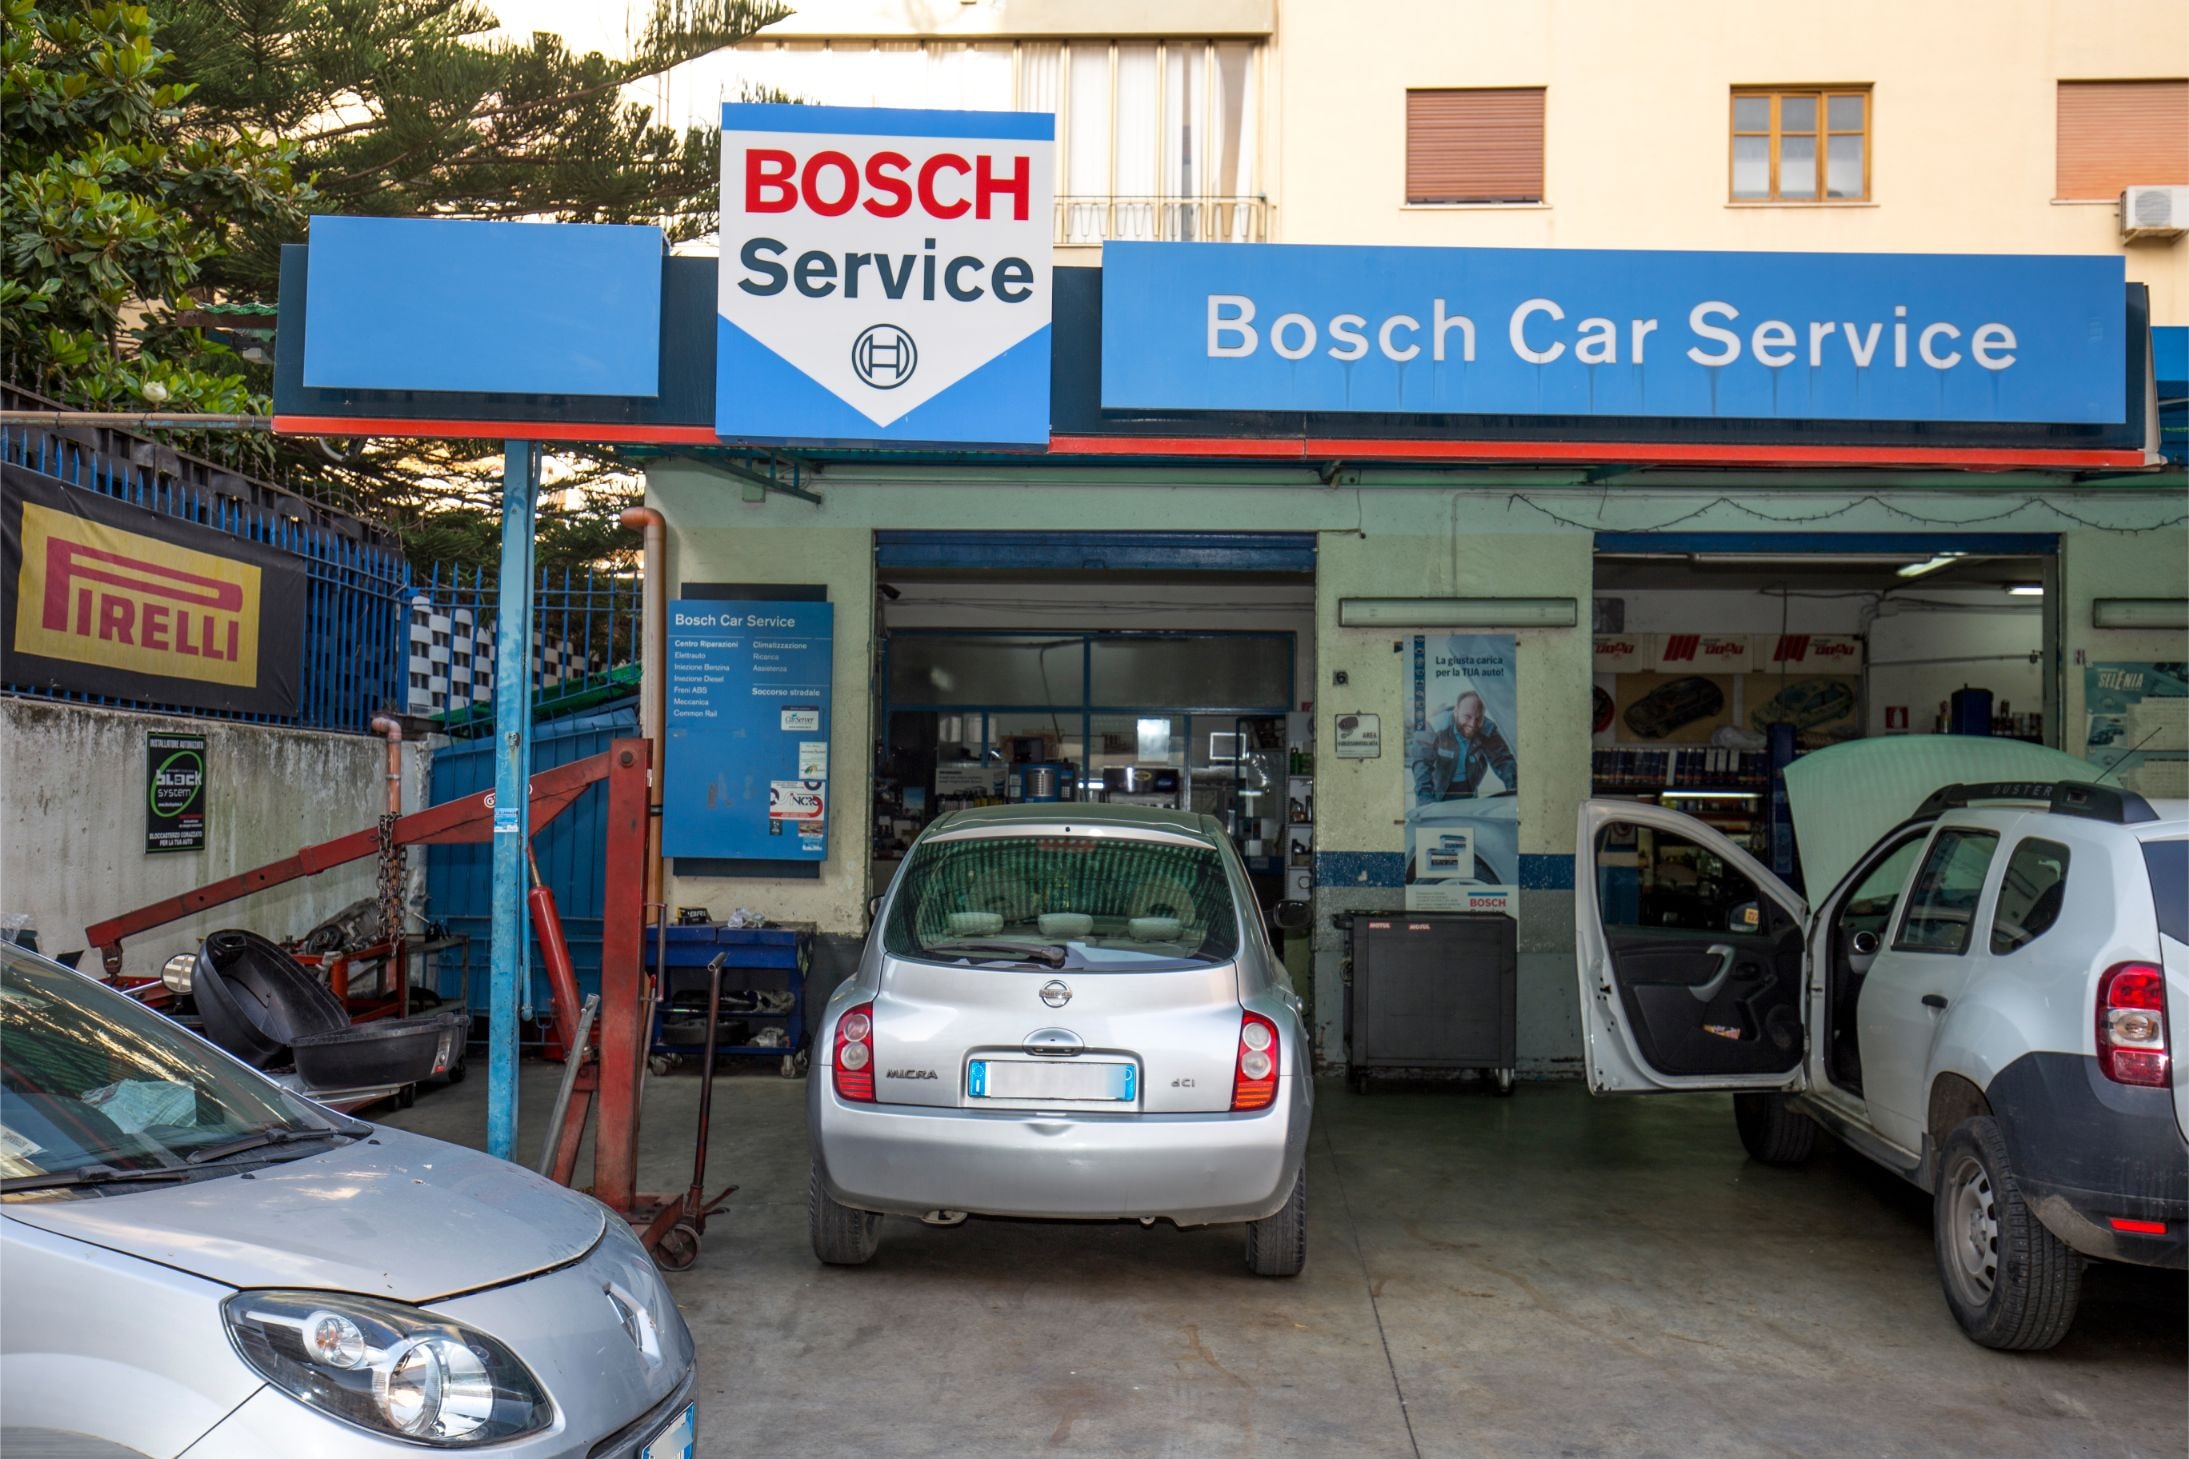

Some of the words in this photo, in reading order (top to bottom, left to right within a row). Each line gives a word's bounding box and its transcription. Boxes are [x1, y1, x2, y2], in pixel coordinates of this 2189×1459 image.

[744, 148, 1031, 222] BOSCH
[737, 237, 1035, 304] Service
[1205, 293, 1477, 363] Bosch
[1507, 297, 1659, 365] Car
[1686, 300, 2018, 371] Service
[42, 536, 244, 662] PIRELLI
[675, 613, 716, 626] Bosch
[720, 614, 743, 627] Car
[747, 615, 796, 628] Service
[674, 640, 699, 648] Centro
[700, 640, 739, 649] Riparazioni
[752, 641, 808, 649] Climatizzazione
[674, 651, 706, 659] Elettrauto
[1435, 656, 1446, 665] La
[1448, 656, 1474, 667] giusta
[1476, 656, 1504, 665] carica
[674, 663, 703, 671] Iniezione
[752, 665, 788, 673] Assistenza
[1435, 669, 1451, 678] per
[1452, 667, 1460, 677] la
[1462, 668, 1480, 677] TUA
[1481, 668, 1504, 677] auto!
[703, 675, 725, 683] Diesel
[2098, 670, 2145, 691] SELENIA
[673, 686, 691, 694] Freni
[751, 687, 788, 696] Soccorso
[789, 688, 821, 697] stradale
[673, 698, 709, 706] Meccanica
[673, 709, 704, 718] Common
[704, 710, 718, 718] Rail
[157, 788, 192, 798] system
[1991, 783, 2054, 797] DUSTER
[1469, 898, 1507, 908] BOSCH
[886, 1069, 939, 1080] MICRA
